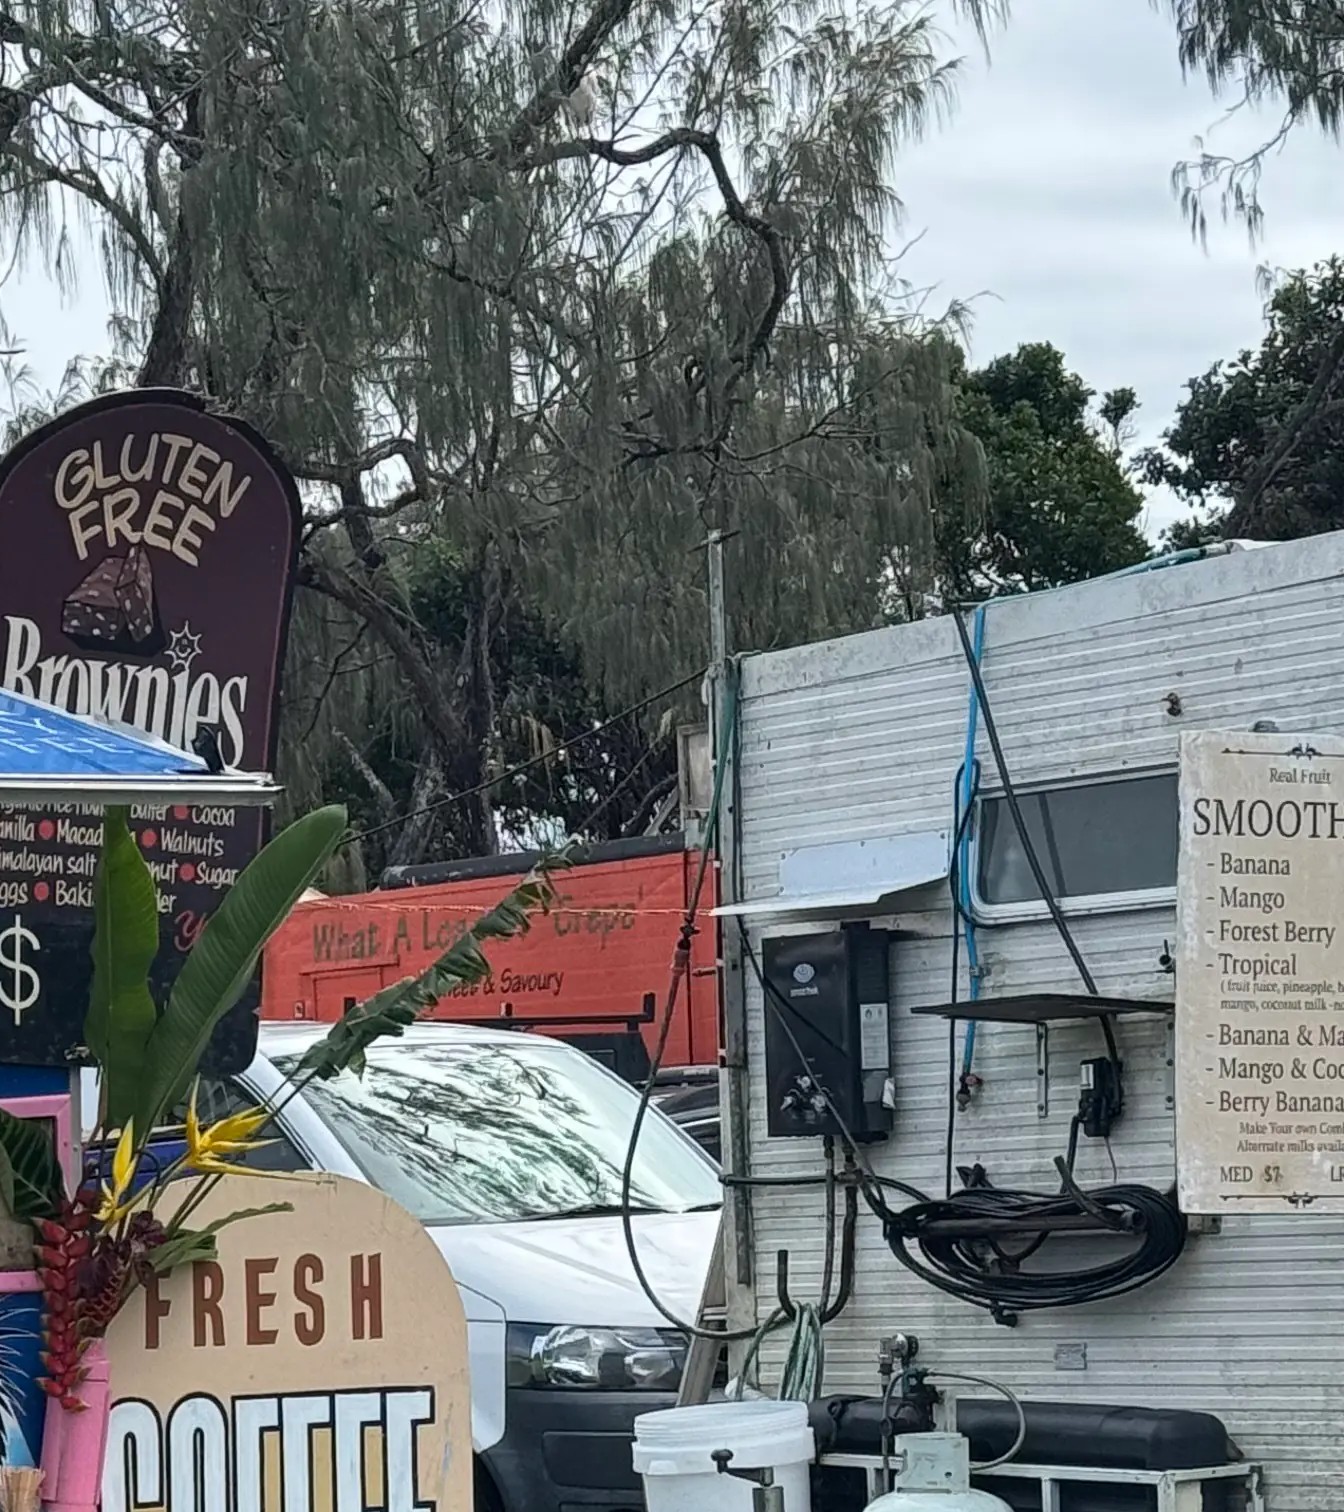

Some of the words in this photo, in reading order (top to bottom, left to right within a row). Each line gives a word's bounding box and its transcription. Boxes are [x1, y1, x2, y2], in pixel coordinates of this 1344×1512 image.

[53, 432, 252, 518] GLUTEN
[69, 487, 216, 568] FREE
[1269, 768, 1298, 783] Real
[1300, 768, 1332, 785] Fruit
[192, 804, 236, 828] Cocoa
[160, 827, 224, 857] Walnuts
[66, 854, 98, 876] salt
[1220, 852, 1291, 875] Banana
[1219, 886, 1285, 914] Mango
[313, 917, 382, 963] What
[392, 910, 411, 952] A
[1219, 919, 1280, 942] Forest
[1284, 920, 1336, 949] Berry
[1218, 952, 1297, 980] Tropical
[500, 968, 565, 996] Savoury
[1218, 1023, 1290, 1046] Banana
[1296, 1024, 1313, 1047] &
[1218, 1057, 1284, 1084] Mango
[1290, 1057, 1308, 1080] &
[1219, 1090, 1271, 1117] Berry
[1275, 1090, 1344, 1112] Banana
[1220, 1165, 1254, 1183] MED
